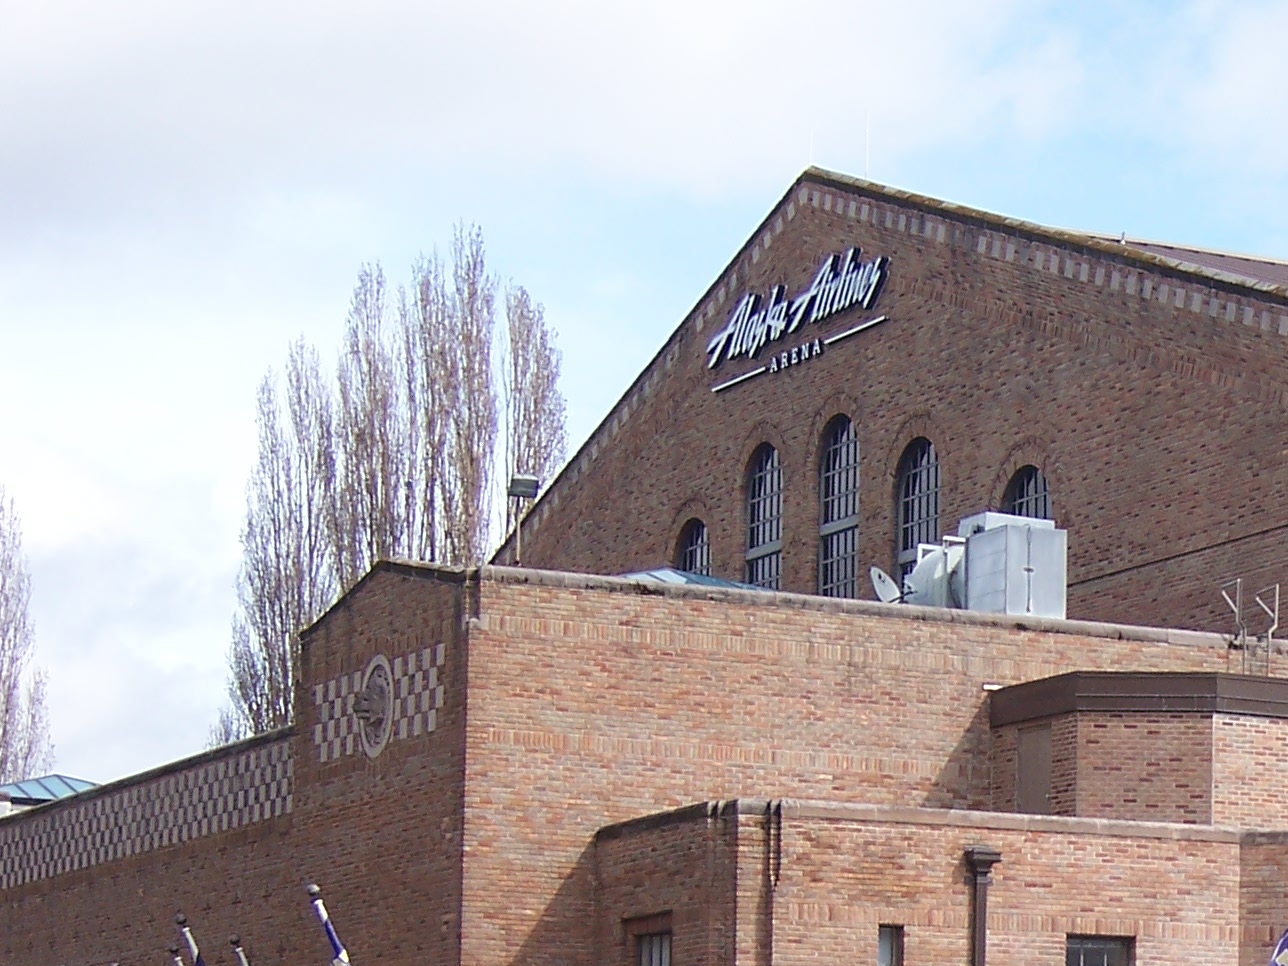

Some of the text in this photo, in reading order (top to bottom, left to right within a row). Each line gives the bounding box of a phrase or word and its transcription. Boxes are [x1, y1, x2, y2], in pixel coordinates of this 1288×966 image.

[706, 247, 890, 369] Alaska Airlines
[769, 339, 822, 373] ARENA
